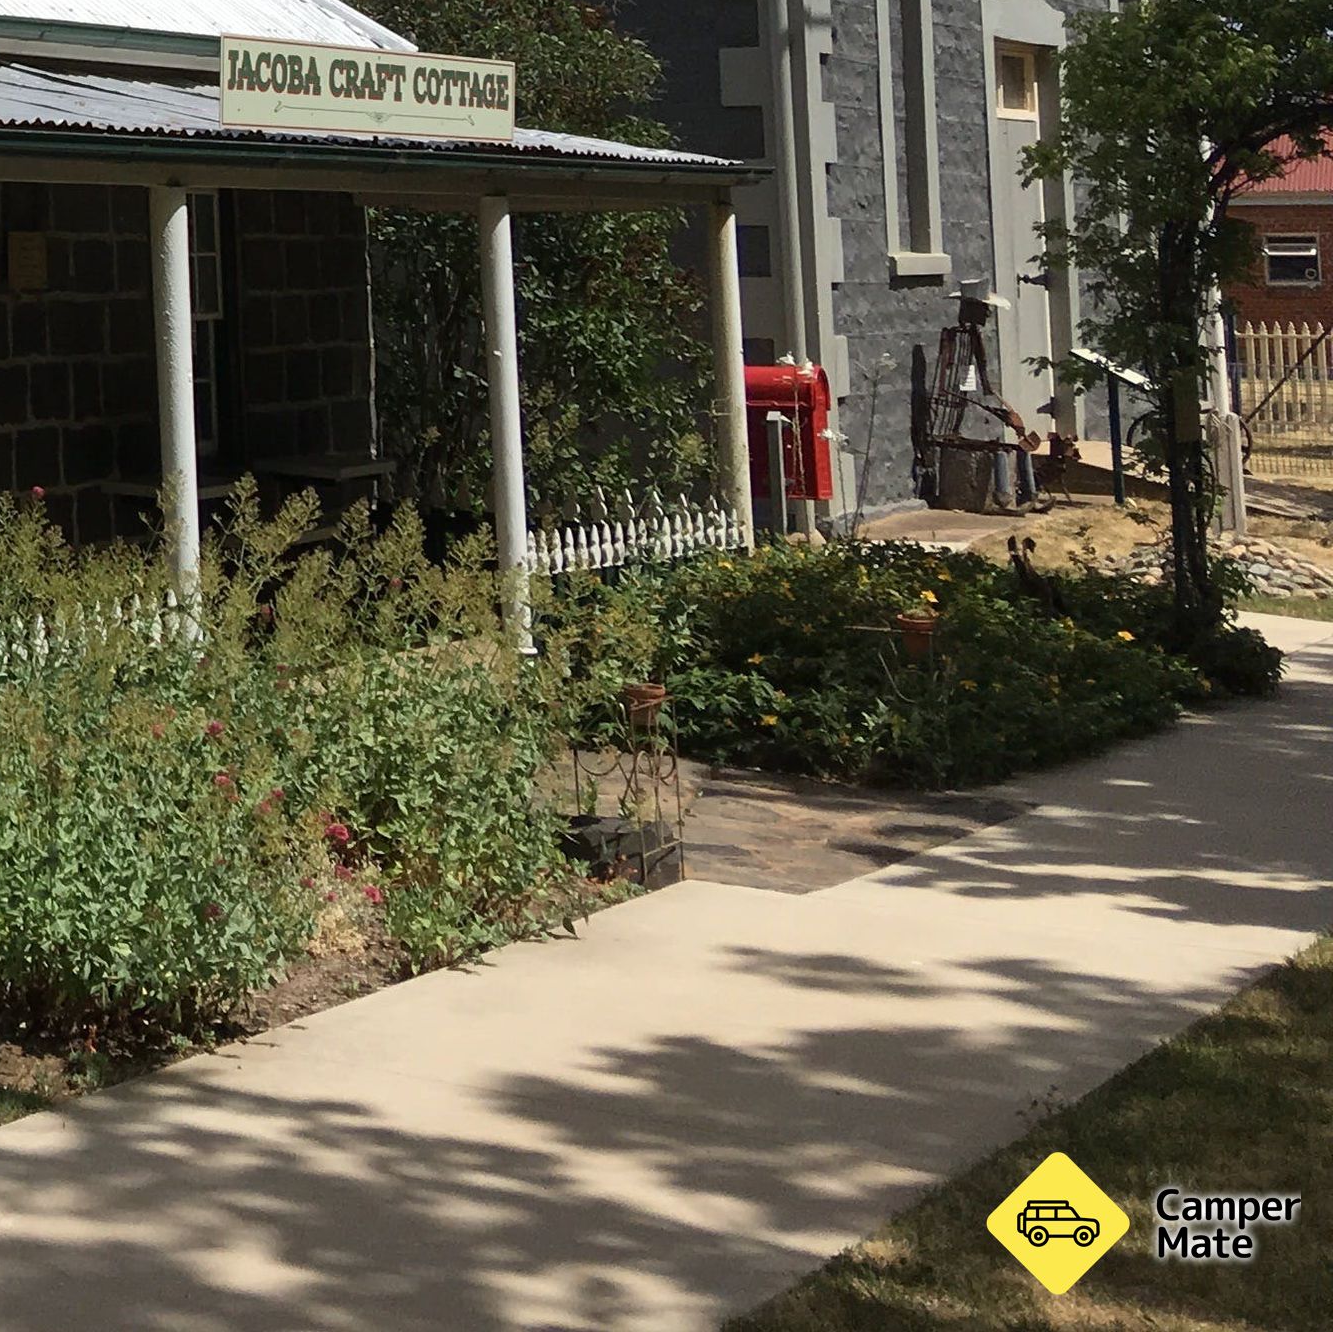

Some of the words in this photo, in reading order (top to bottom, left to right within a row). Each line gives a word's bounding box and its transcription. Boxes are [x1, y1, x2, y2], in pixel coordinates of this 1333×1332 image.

[227, 49, 322, 97] JACOBA
[328, 57, 407, 103] CRAFT
[412, 65, 510, 112] COTTAGE
